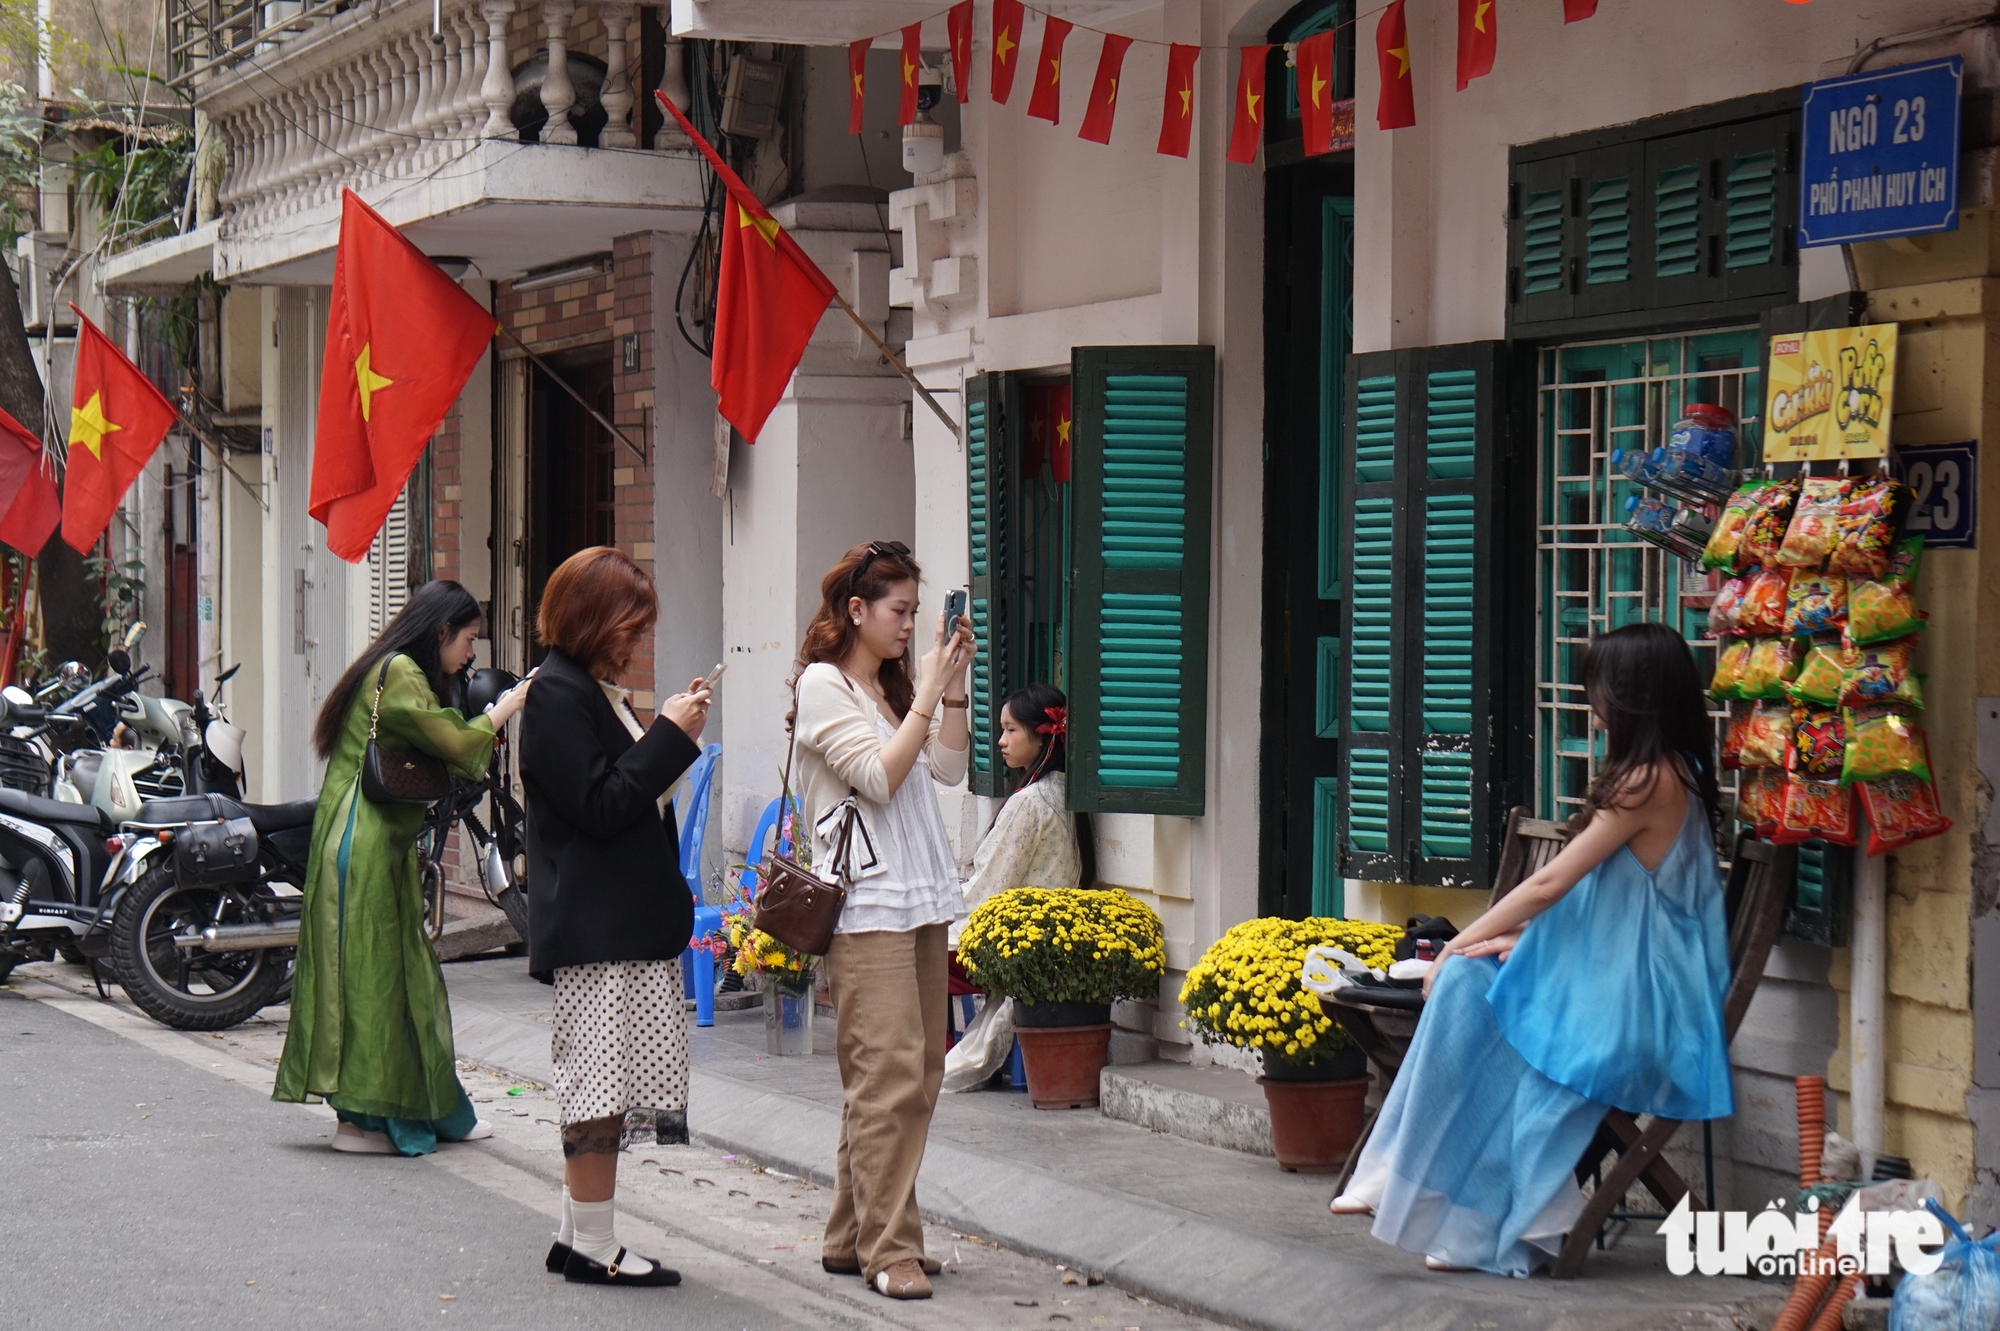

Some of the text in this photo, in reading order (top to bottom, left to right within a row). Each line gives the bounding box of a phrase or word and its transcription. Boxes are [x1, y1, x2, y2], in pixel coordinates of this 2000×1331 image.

[1829, 94, 1926, 154] NGÕ 23
[1809, 161, 1946, 216] PHỐ PHAN HUY ÍCH
[1906, 460, 1960, 530] 23
